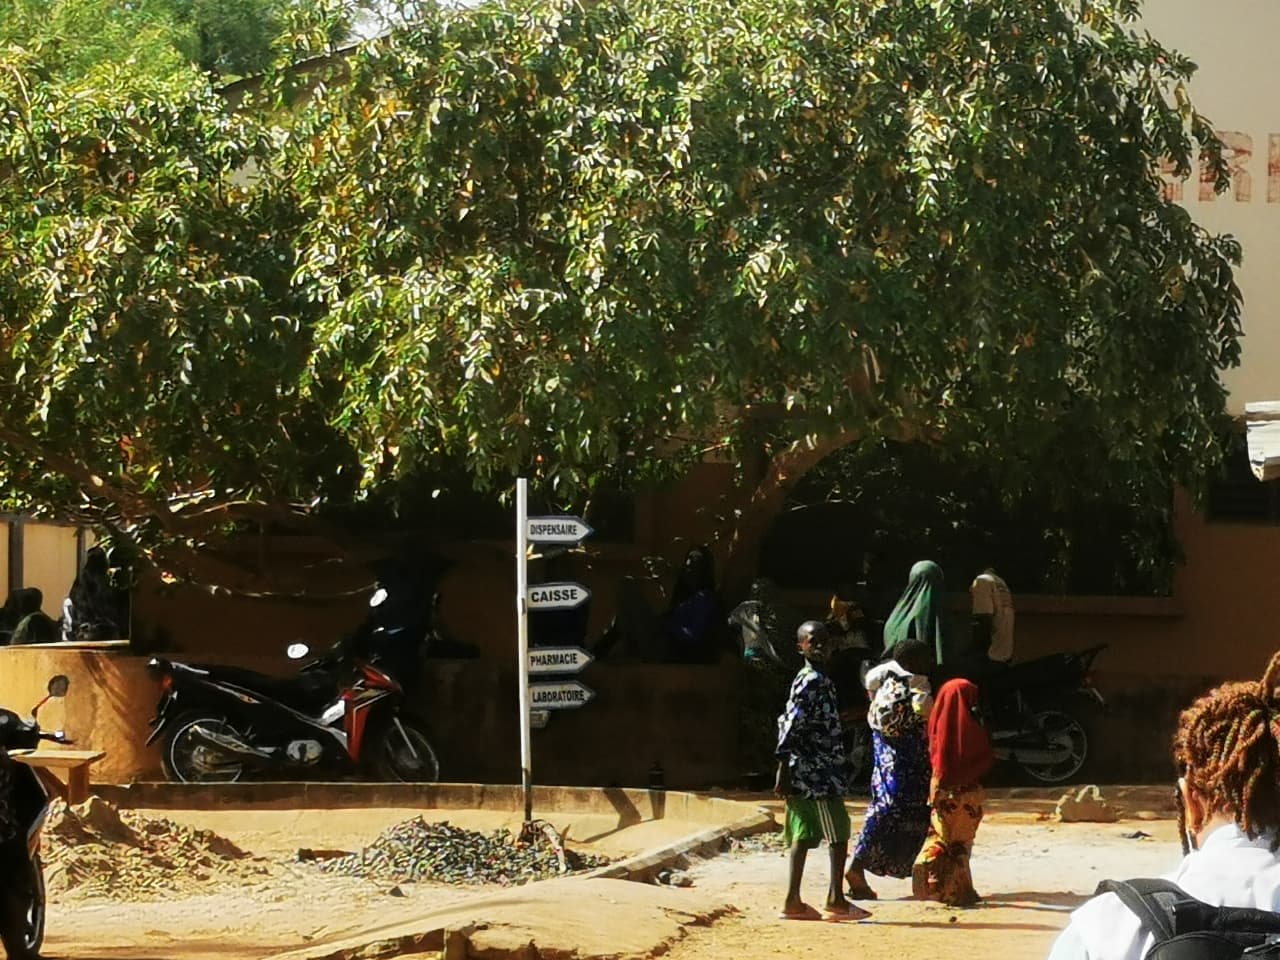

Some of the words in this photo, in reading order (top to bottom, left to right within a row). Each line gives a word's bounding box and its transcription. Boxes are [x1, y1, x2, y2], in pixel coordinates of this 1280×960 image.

[530, 524, 577, 536] DISPENSAIRE
[531, 589, 578, 602] CAISSE
[530, 653, 578, 667] PHARMACIE
[532, 690, 585, 702] LABORATOIRE
